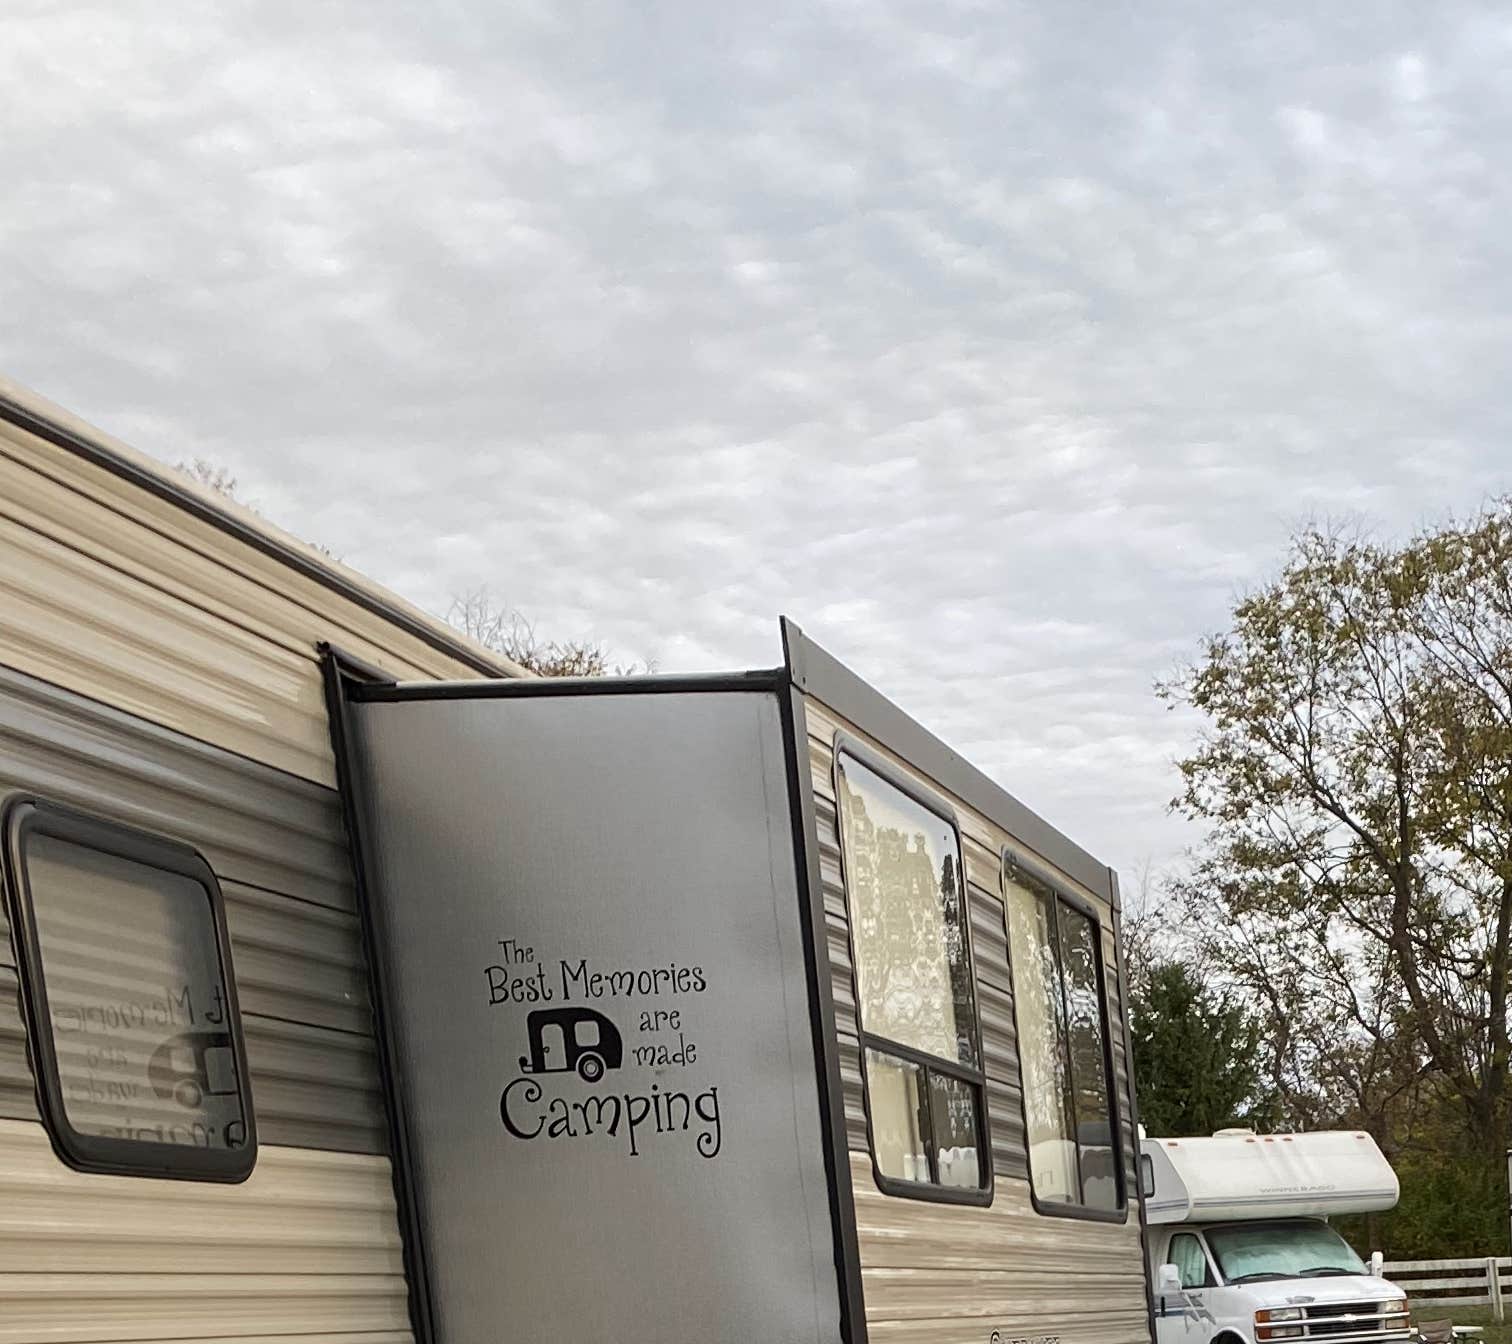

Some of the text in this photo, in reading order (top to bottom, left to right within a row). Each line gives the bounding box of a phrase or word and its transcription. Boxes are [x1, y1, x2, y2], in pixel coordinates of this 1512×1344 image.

[498, 940, 534, 964] The
[484, 960, 706, 1006] Best Memories
[639, 1007, 681, 1031] are
[632, 1033, 697, 1067] made
[500, 1077, 721, 1158] Camping
